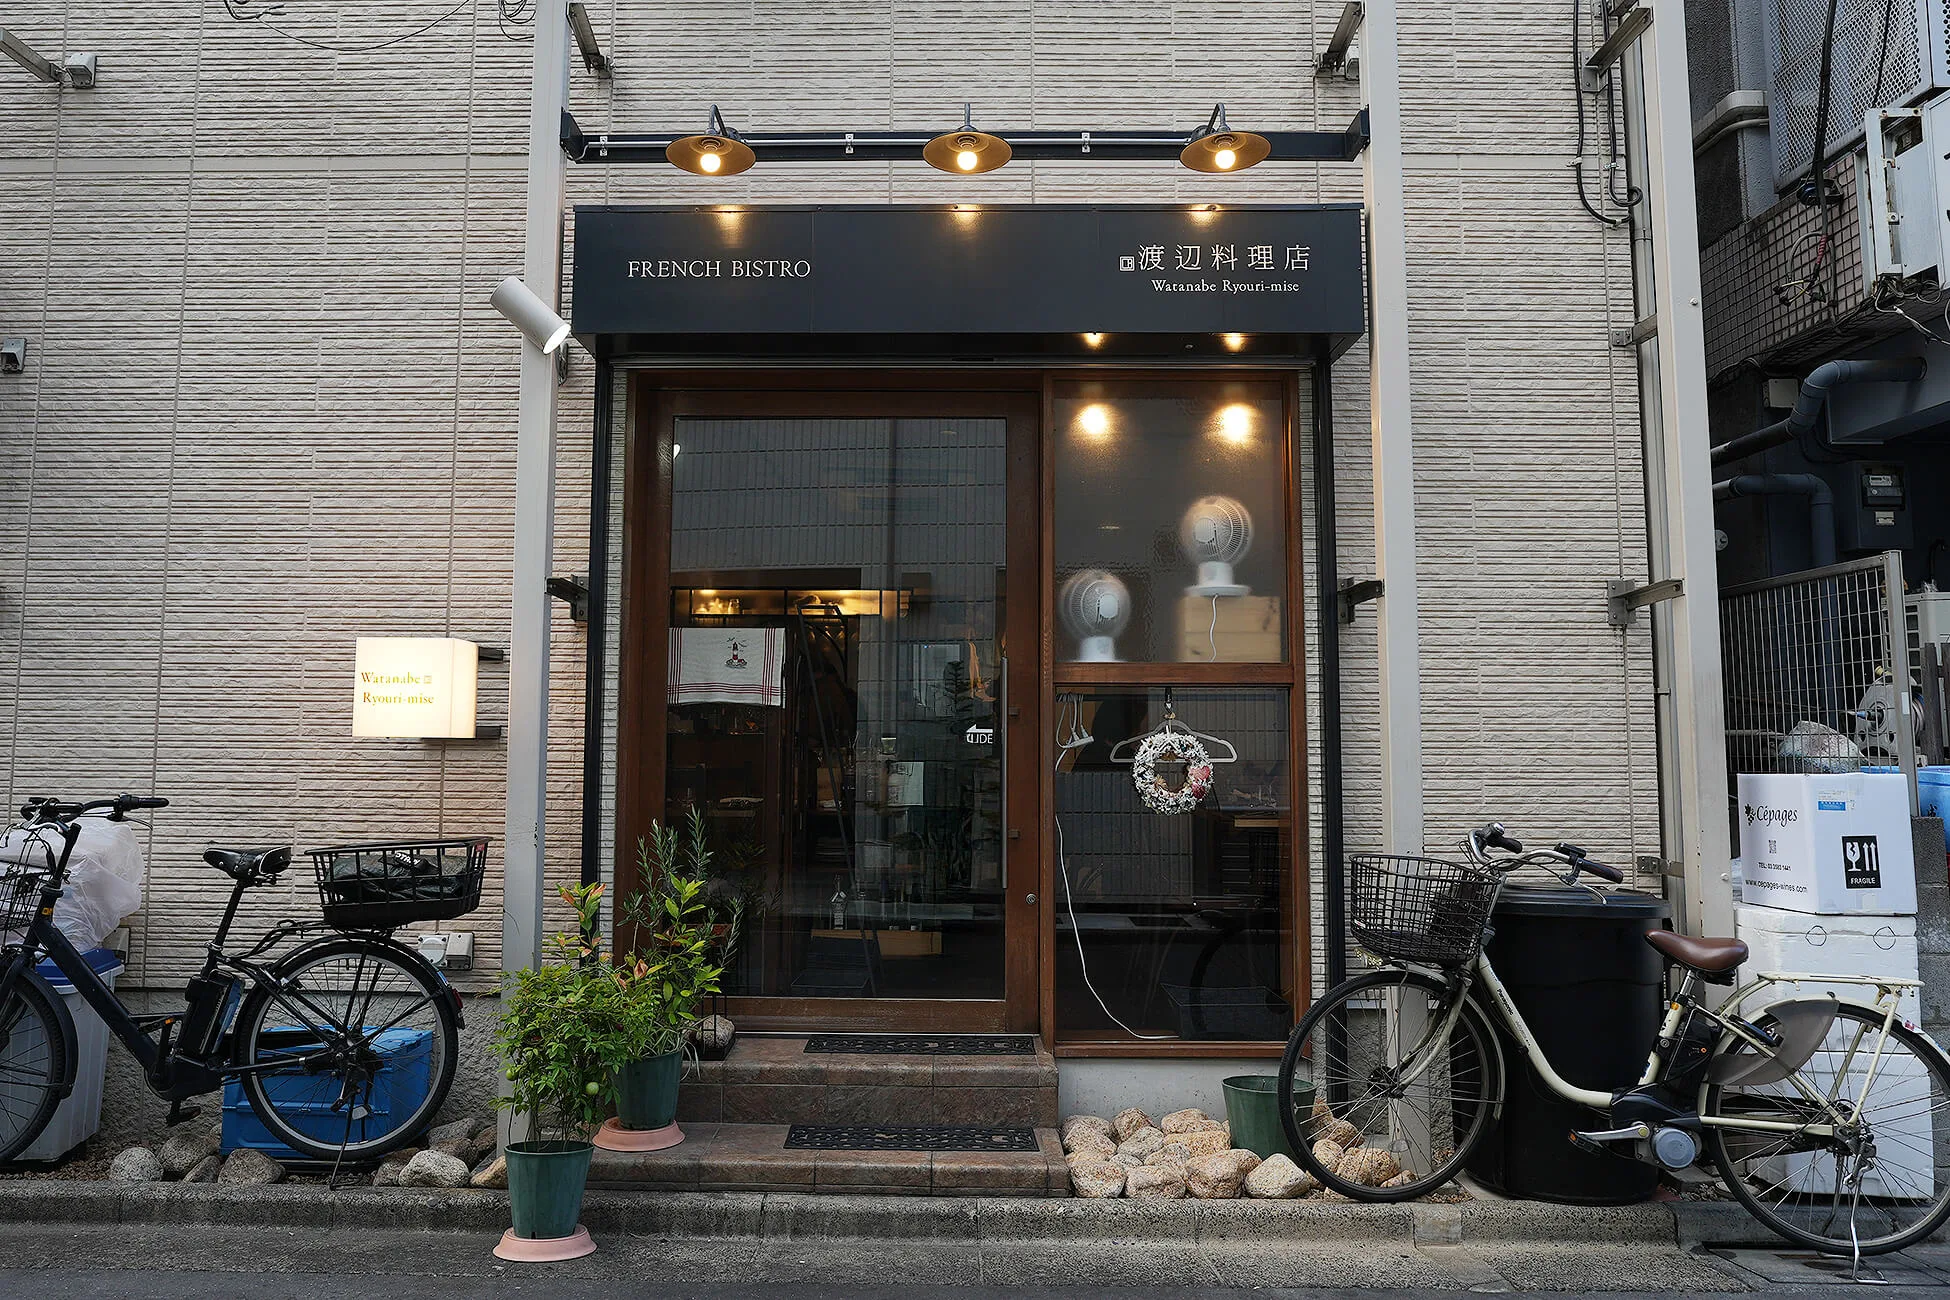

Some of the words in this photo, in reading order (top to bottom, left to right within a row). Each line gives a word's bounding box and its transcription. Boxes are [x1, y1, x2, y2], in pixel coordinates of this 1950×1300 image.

[1138, 244, 1311, 271] 渡辺料理店
[628, 260, 721, 278] FRENCH
[731, 260, 811, 278] BISTRO
[1151, 279, 1217, 292] Watanabe
[1222, 279, 1300, 294] Ryouri-mise
[361, 671, 421, 685] Watanabe
[363, 691, 434, 706] Ryouri-mise
[1756, 805, 1798, 828] Cépages
[1850, 877, 1876, 885] FRAGILE
